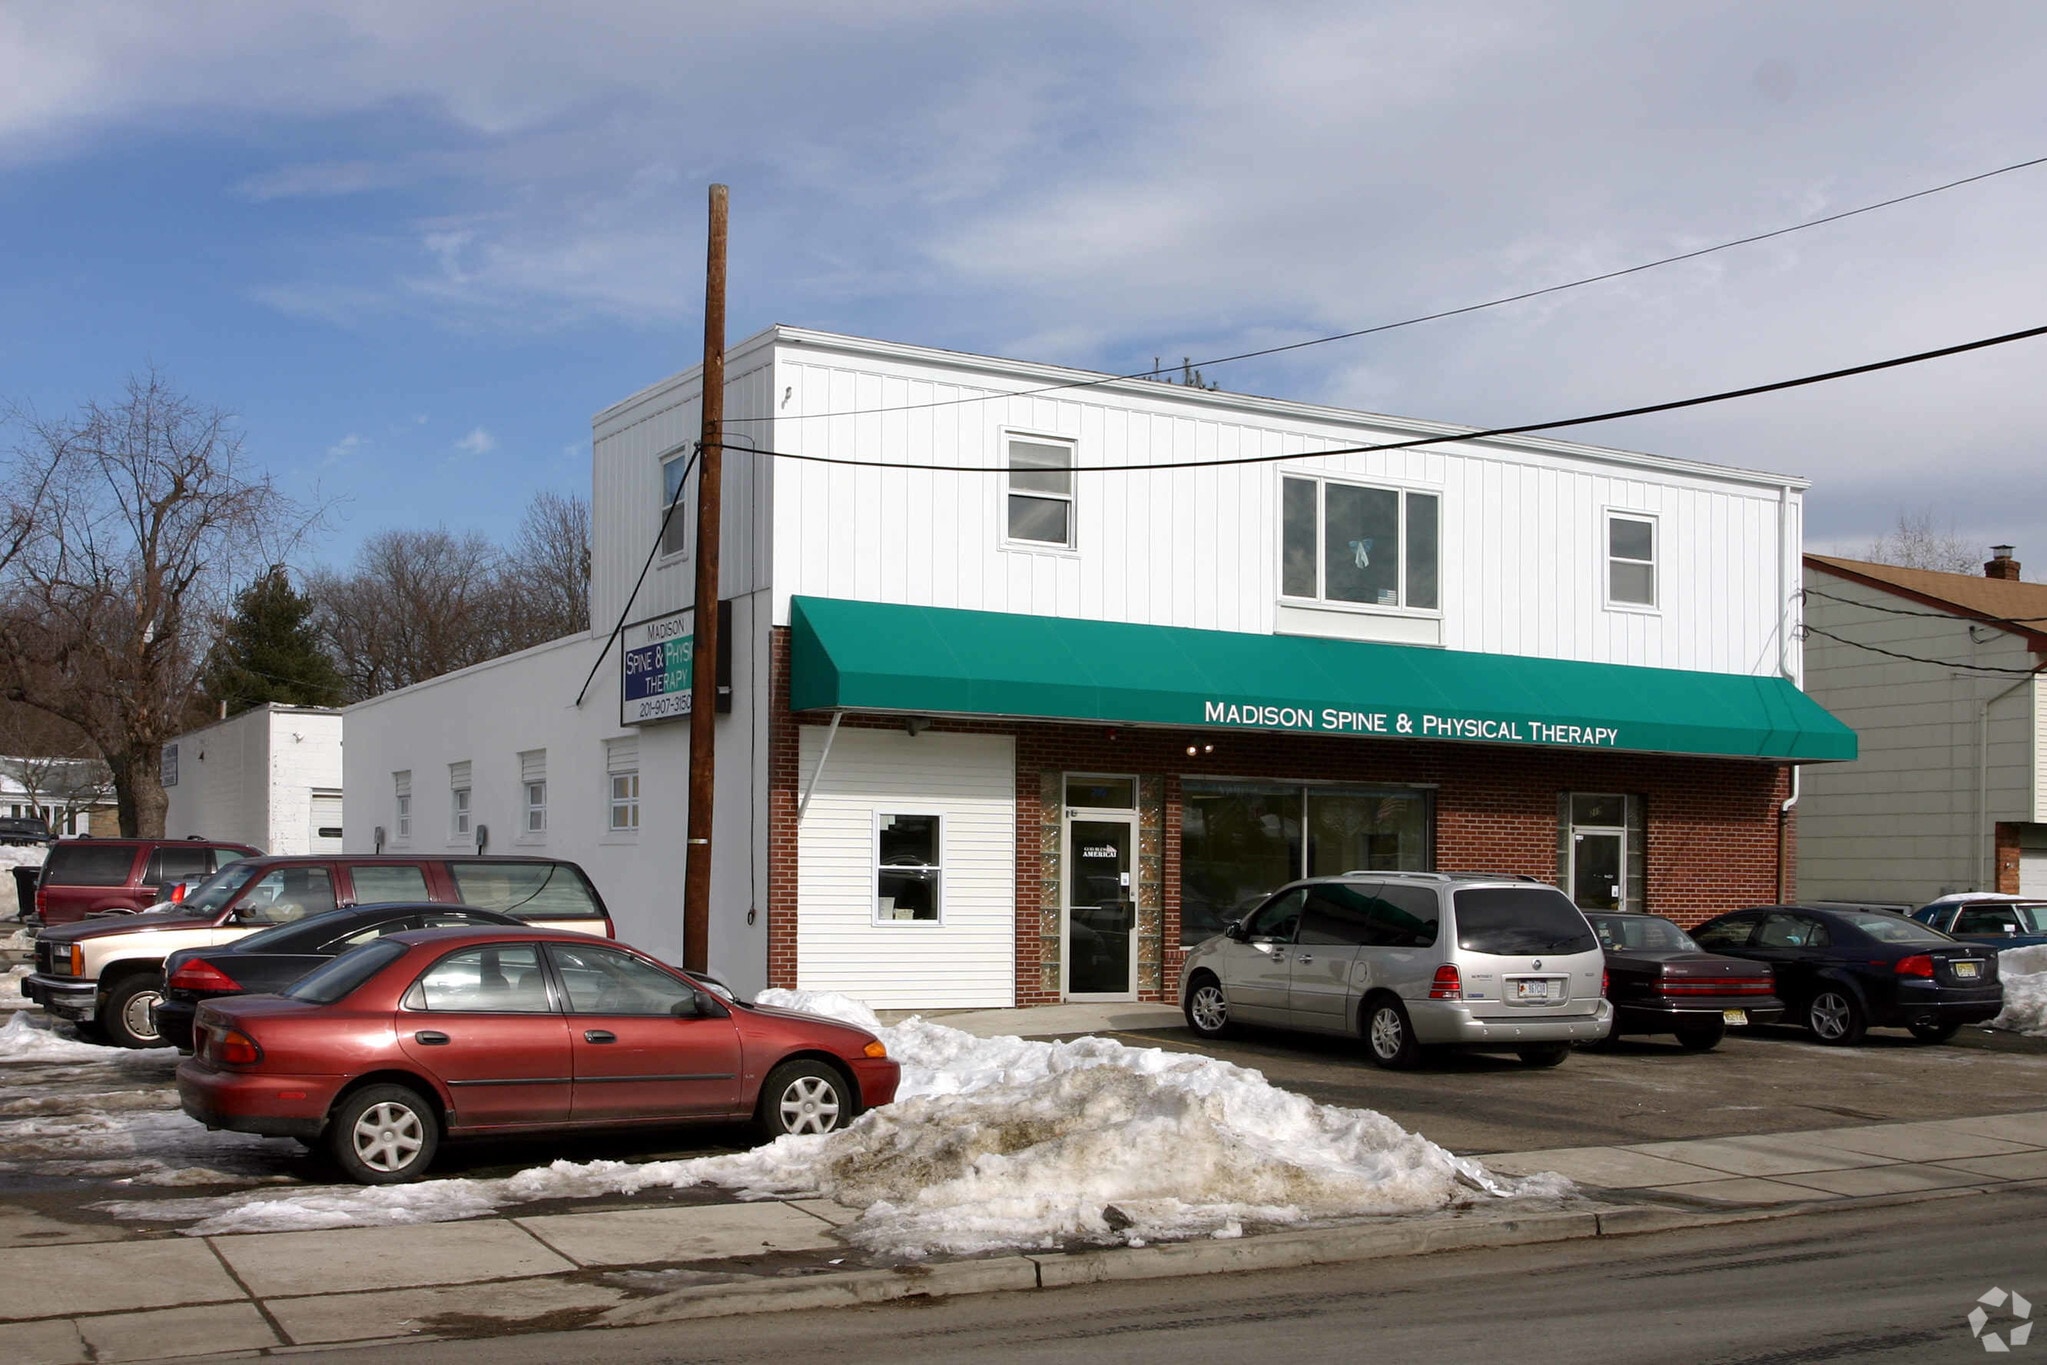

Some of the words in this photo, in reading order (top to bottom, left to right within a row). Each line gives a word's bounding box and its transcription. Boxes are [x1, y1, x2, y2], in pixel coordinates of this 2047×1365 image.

[648, 619, 685, 641] MADISON
[626, 652, 652, 675] SPINE
[655, 646, 664, 669] &
[665, 643, 693, 666] PHYSI
[645, 669, 688, 695] THERAPY
[1205, 701, 1313, 728] MADISON
[1322, 709, 1387, 732] SPINE
[1396, 713, 1413, 734] &
[1423, 715, 1522, 740] PHYSICAL
[1528, 722, 1618, 746] THERAPY
